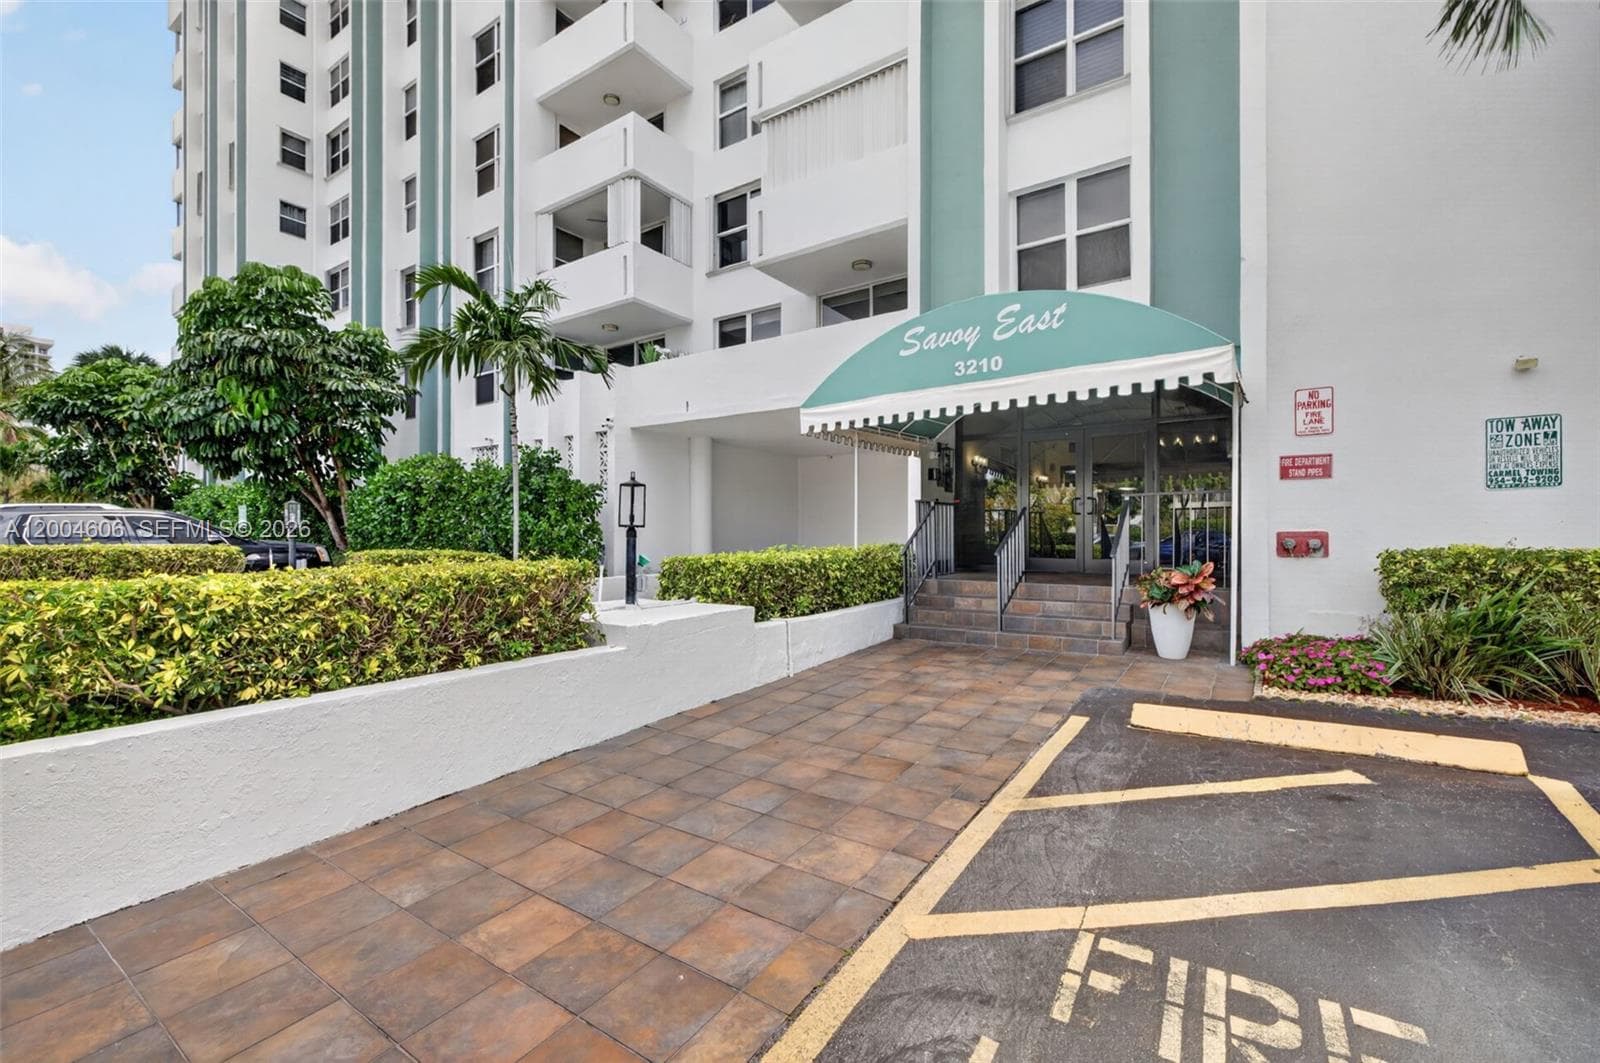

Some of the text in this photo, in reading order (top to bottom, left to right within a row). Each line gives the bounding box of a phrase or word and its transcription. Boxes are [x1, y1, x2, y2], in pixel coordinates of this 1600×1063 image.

[898, 302, 1068, 357] Savoy East
[953, 355, 1004, 377] 3210
[1308, 390, 1320, 400] NO
[1297, 399, 1332, 410] PARKING
[1488, 416, 1558, 433] TOW AWAY
[1505, 433, 1541, 447] ZONE
[1281, 456, 1330, 466] FIRE DEPARTMENT
[1289, 468, 1323, 477] STAND PIPES
[1525, 468, 1560, 476] TOWING
